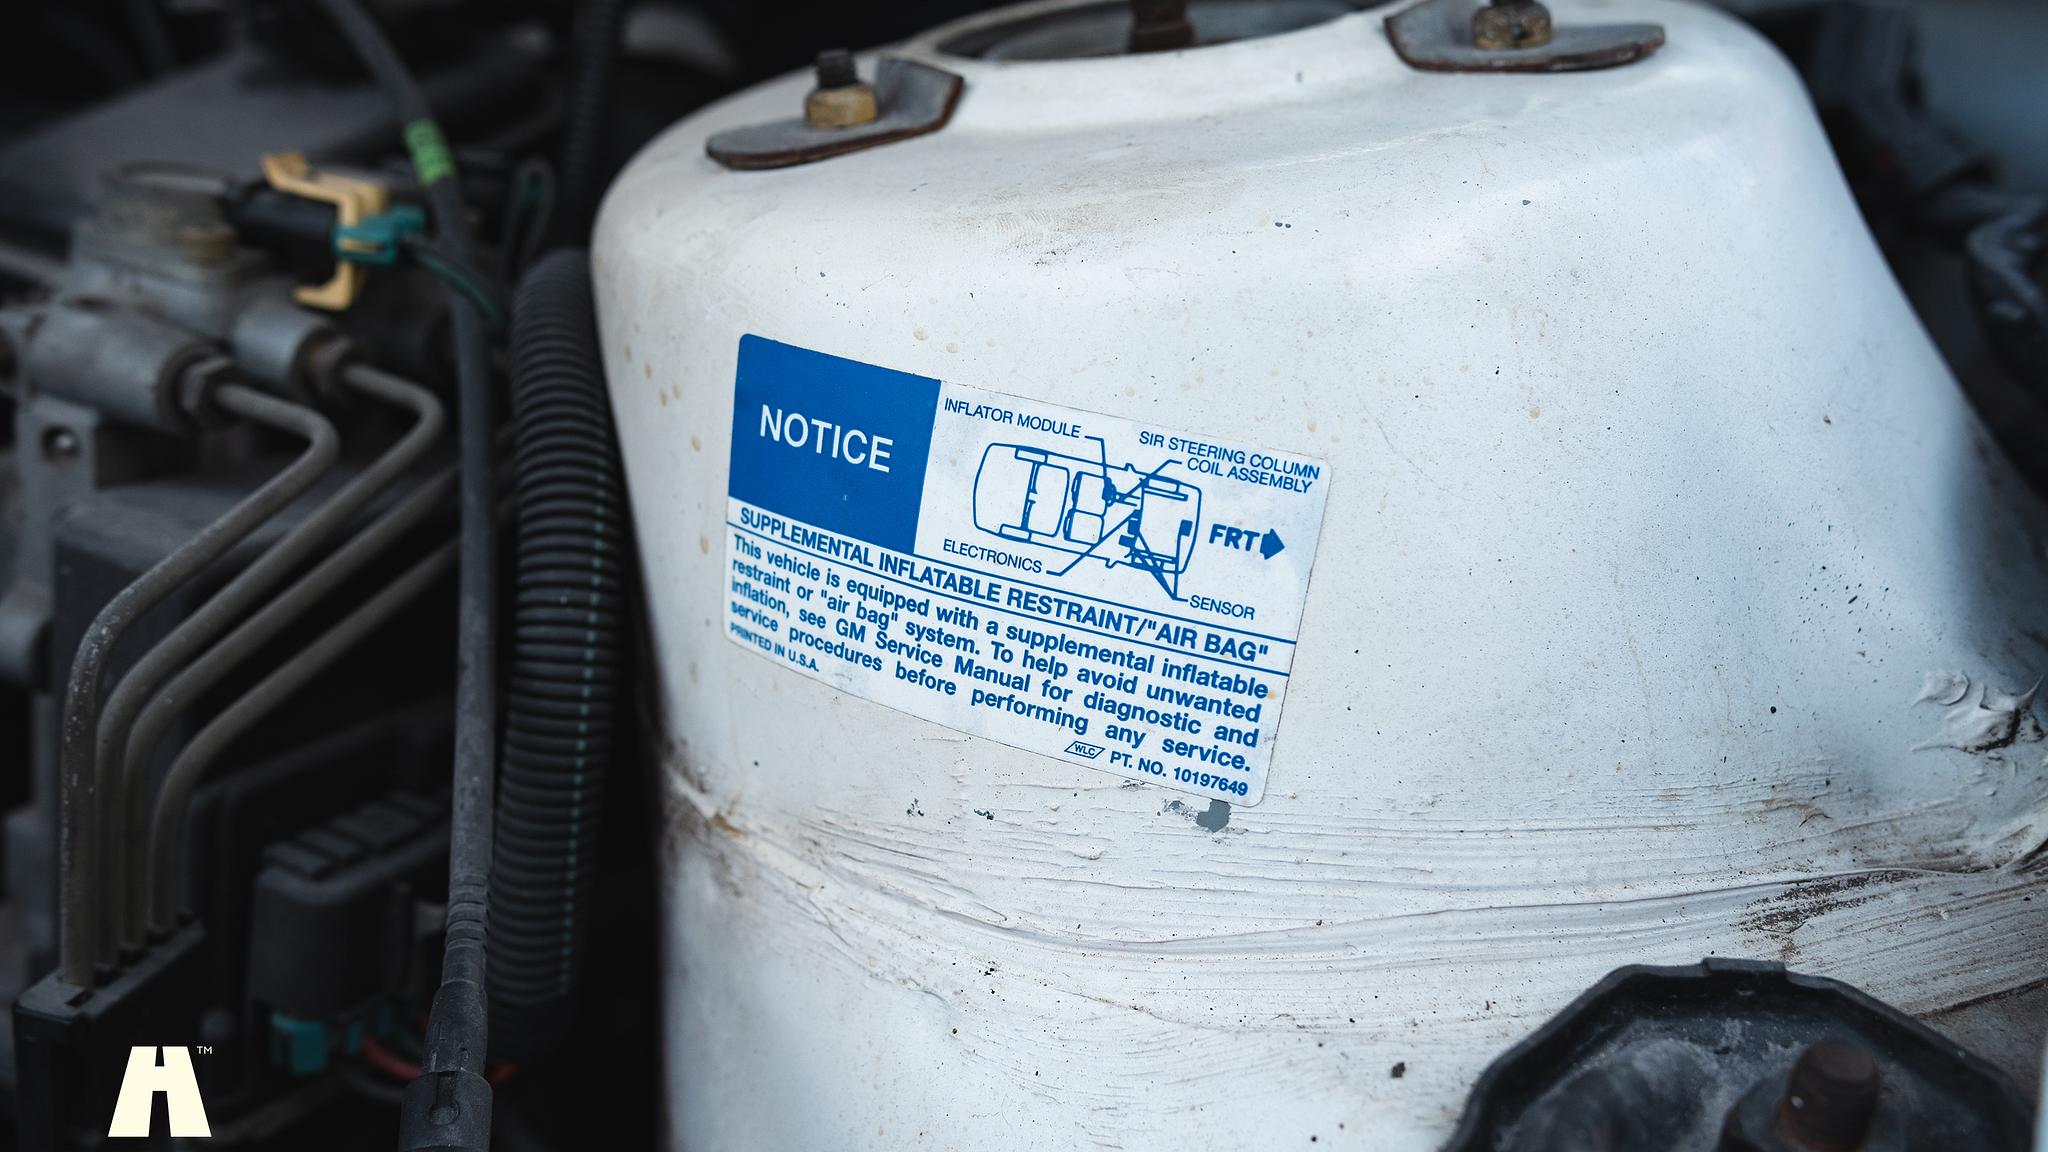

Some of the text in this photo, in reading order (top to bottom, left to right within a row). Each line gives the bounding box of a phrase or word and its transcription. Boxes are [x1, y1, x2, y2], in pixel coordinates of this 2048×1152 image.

[760, 404, 893, 474] NOTICE
[944, 397, 1081, 438] INFLATOR MODULE
[1139, 431, 1320, 480] SIR STEERING COLUMN
[1187, 457, 1313, 494] COIL ASSEMBLY
[943, 538, 1042, 573] ELECTRONICS
[1209, 523, 1261, 552] FRT
[740, 507, 874, 567] SUPPLEMENTAL
[879, 552, 1002, 603] INFLATABLE
[1204, 633, 1269, 662] BAG"
[1190, 594, 1255, 620] SENSOR
[734, 533, 1269, 699] This vehicle is equipped with a supplemental inflatable
[730, 622, 819, 672] PRINTED IN U.S.A.
[732, 576, 1260, 748] inflation, see GM Service Manual for diagnostic and
[733, 559, 1262, 723] restraint or "air bag" system. To help avoid unwanted
[731, 601, 1251, 772] service procedures before performing any service.
[1074, 743, 1096, 757] WLC
[1110, 750, 1248, 796] PT. NO. 10197649
